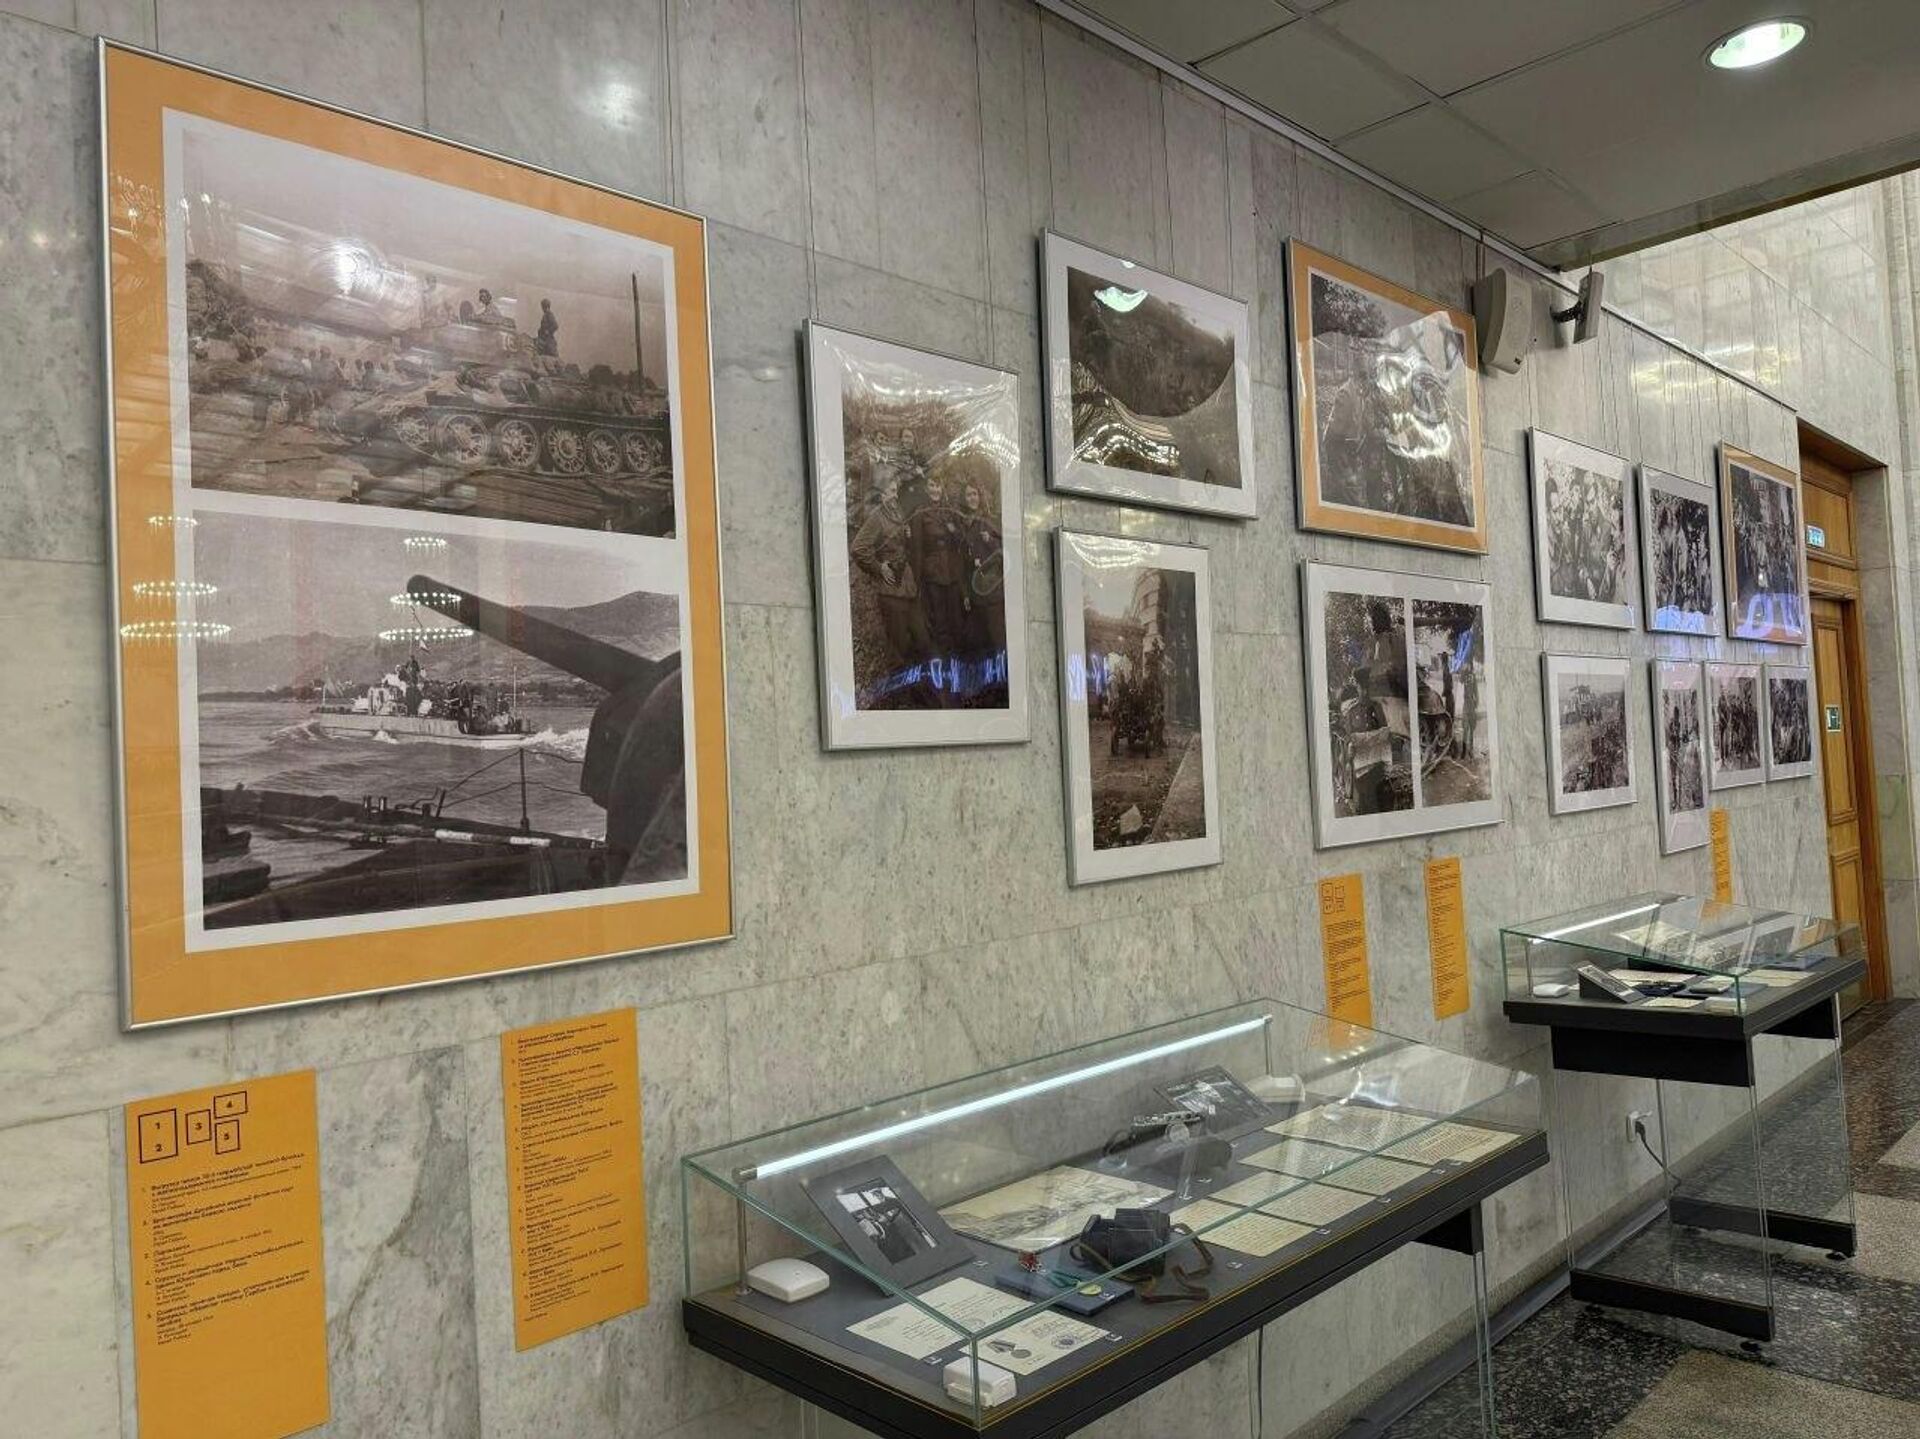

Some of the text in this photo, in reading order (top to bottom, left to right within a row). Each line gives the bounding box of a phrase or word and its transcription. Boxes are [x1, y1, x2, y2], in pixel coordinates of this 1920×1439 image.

[226, 1101, 233, 1109] 4
[155, 1122, 161, 1130] 1
[195, 1122, 202, 1130] 3
[223, 1132, 230, 1141] 5
[155, 1144, 162, 1152] 2
